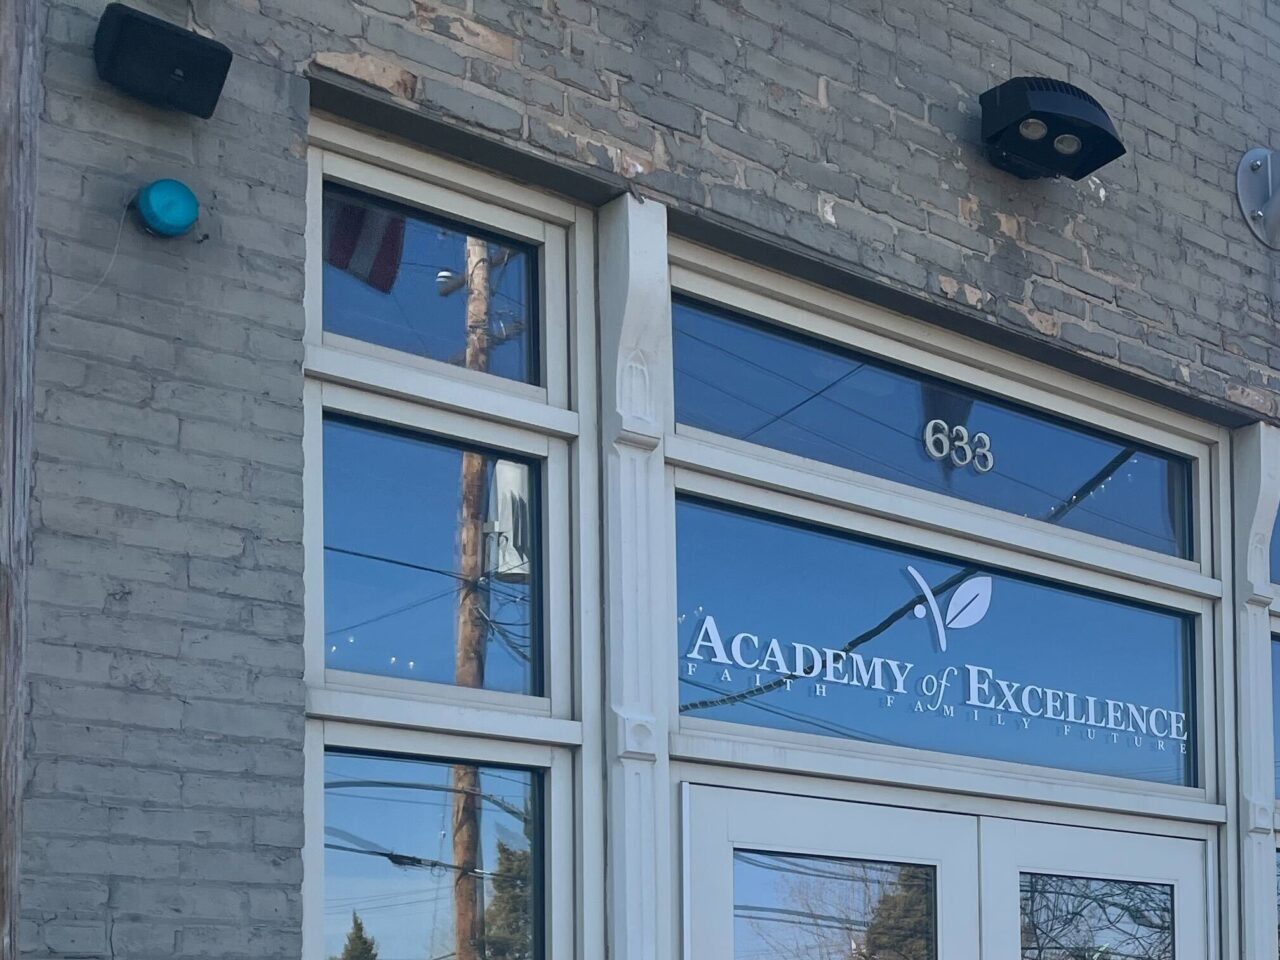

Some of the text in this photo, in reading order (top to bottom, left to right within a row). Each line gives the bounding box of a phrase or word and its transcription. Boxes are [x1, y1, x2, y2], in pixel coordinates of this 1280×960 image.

[924, 419, 994, 473] 633
[686, 615, 1188, 741] ACADEMY of EXCELLENCE
